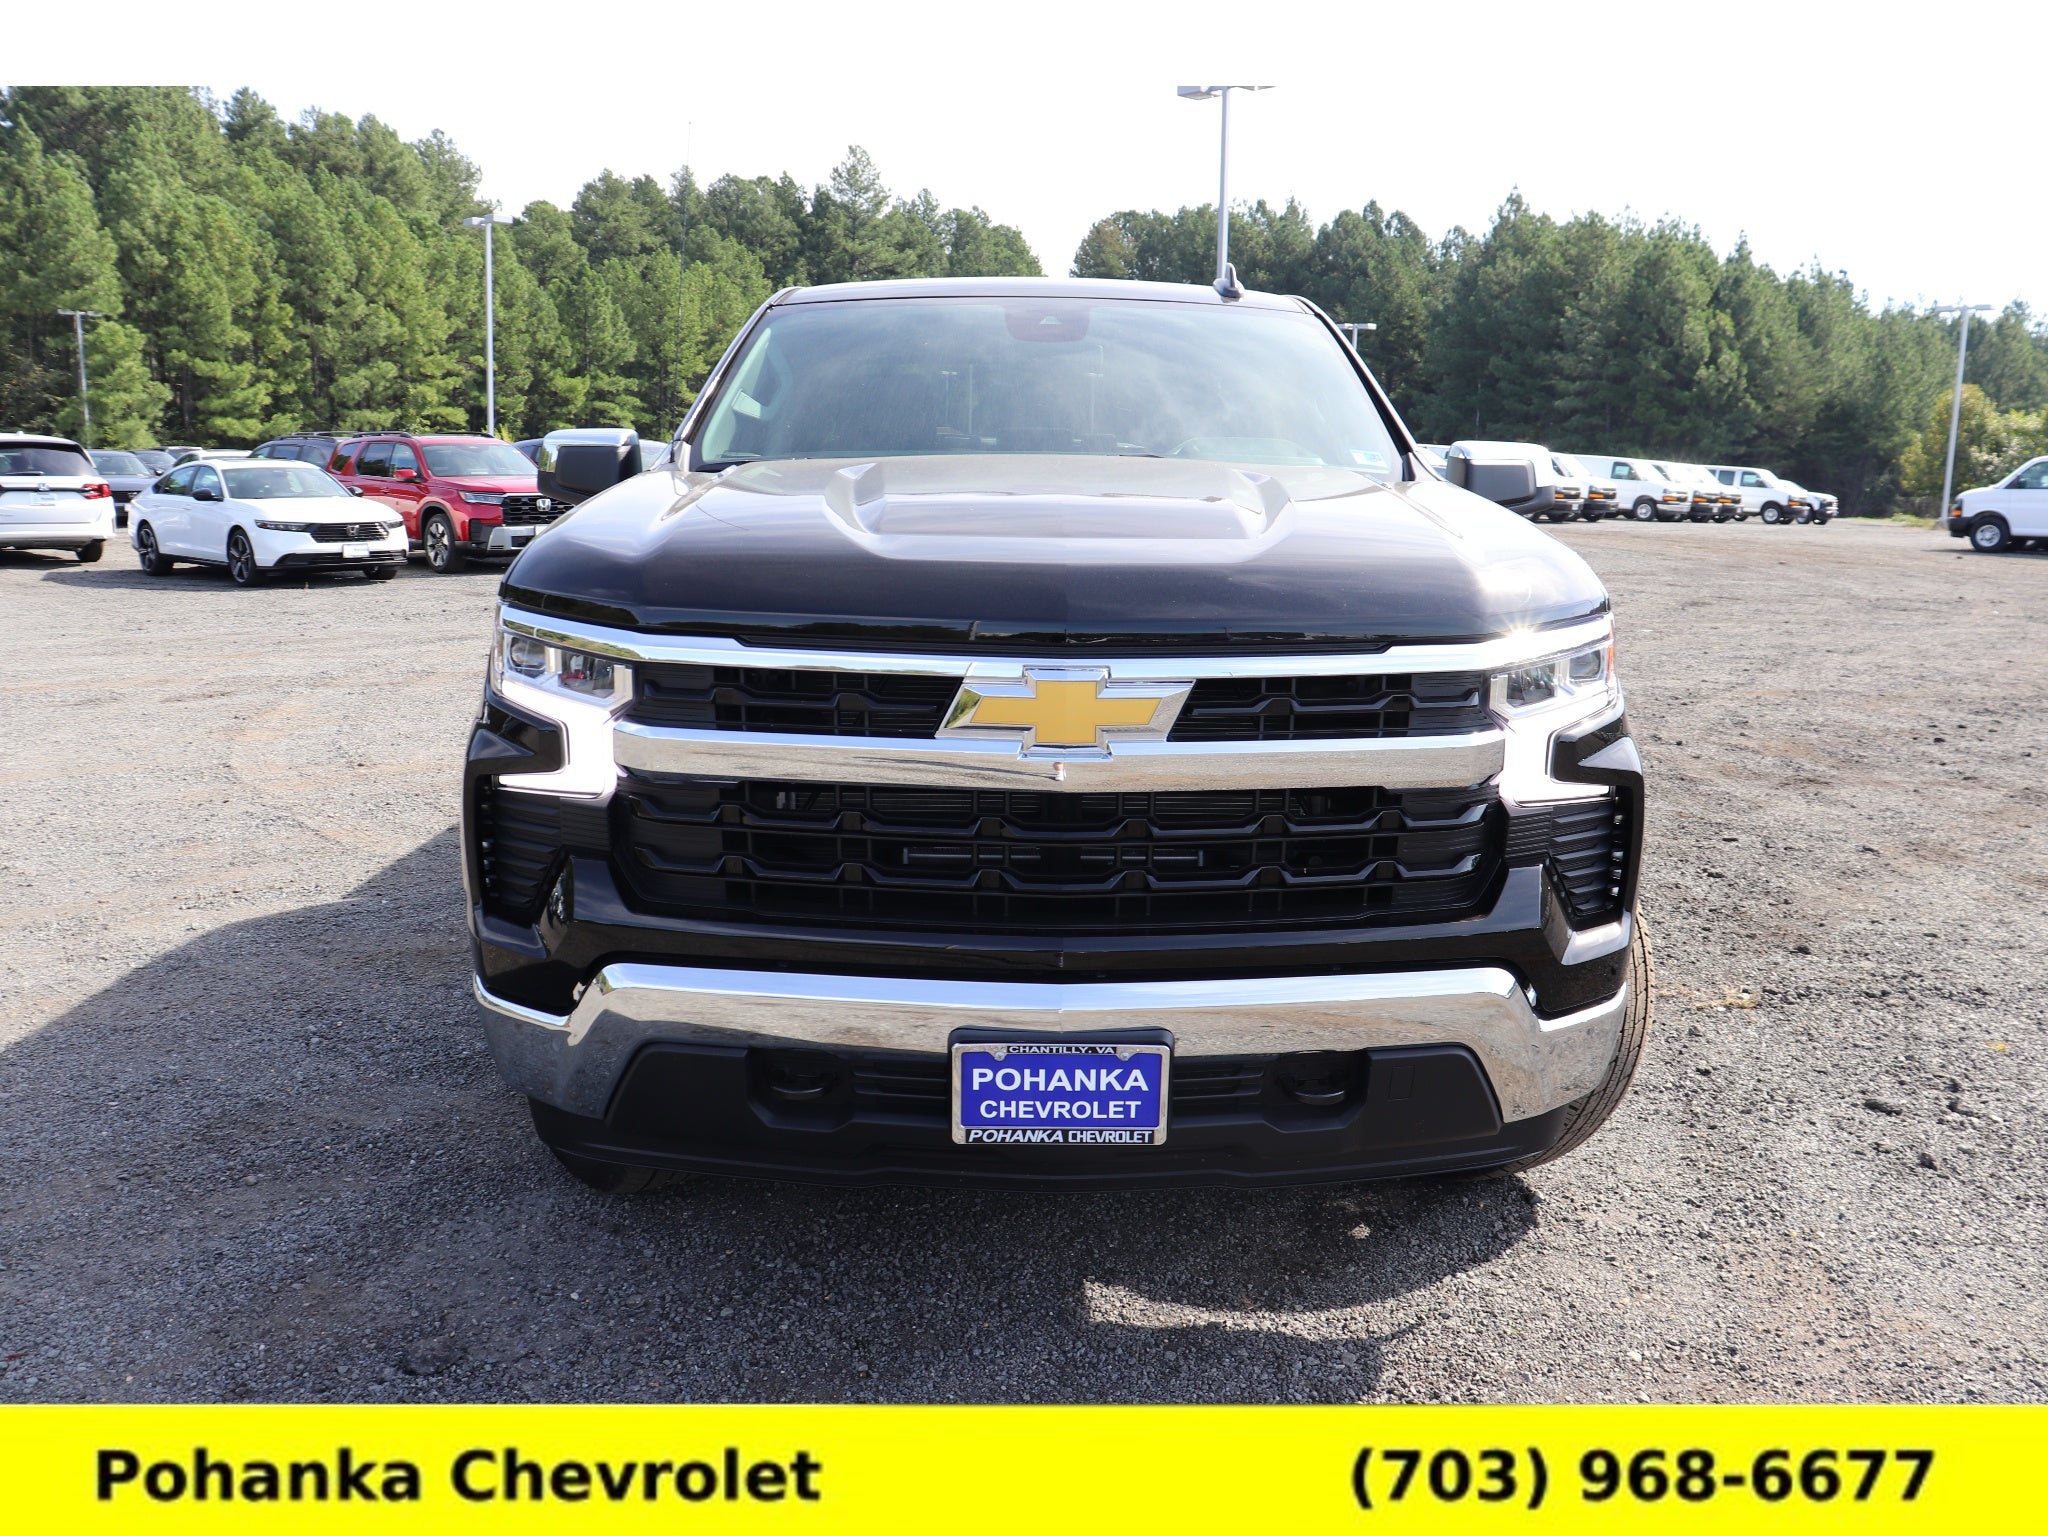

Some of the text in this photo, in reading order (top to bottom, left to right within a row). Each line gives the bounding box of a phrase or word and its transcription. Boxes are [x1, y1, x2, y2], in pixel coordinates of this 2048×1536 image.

[1095, 1046, 1115, 1054] VA
[972, 1068, 1149, 1092] POHANKA
[979, 1100, 1142, 1119] CHEVROLET
[968, 1129, 1152, 1143] POHANKA CHEVROLET
